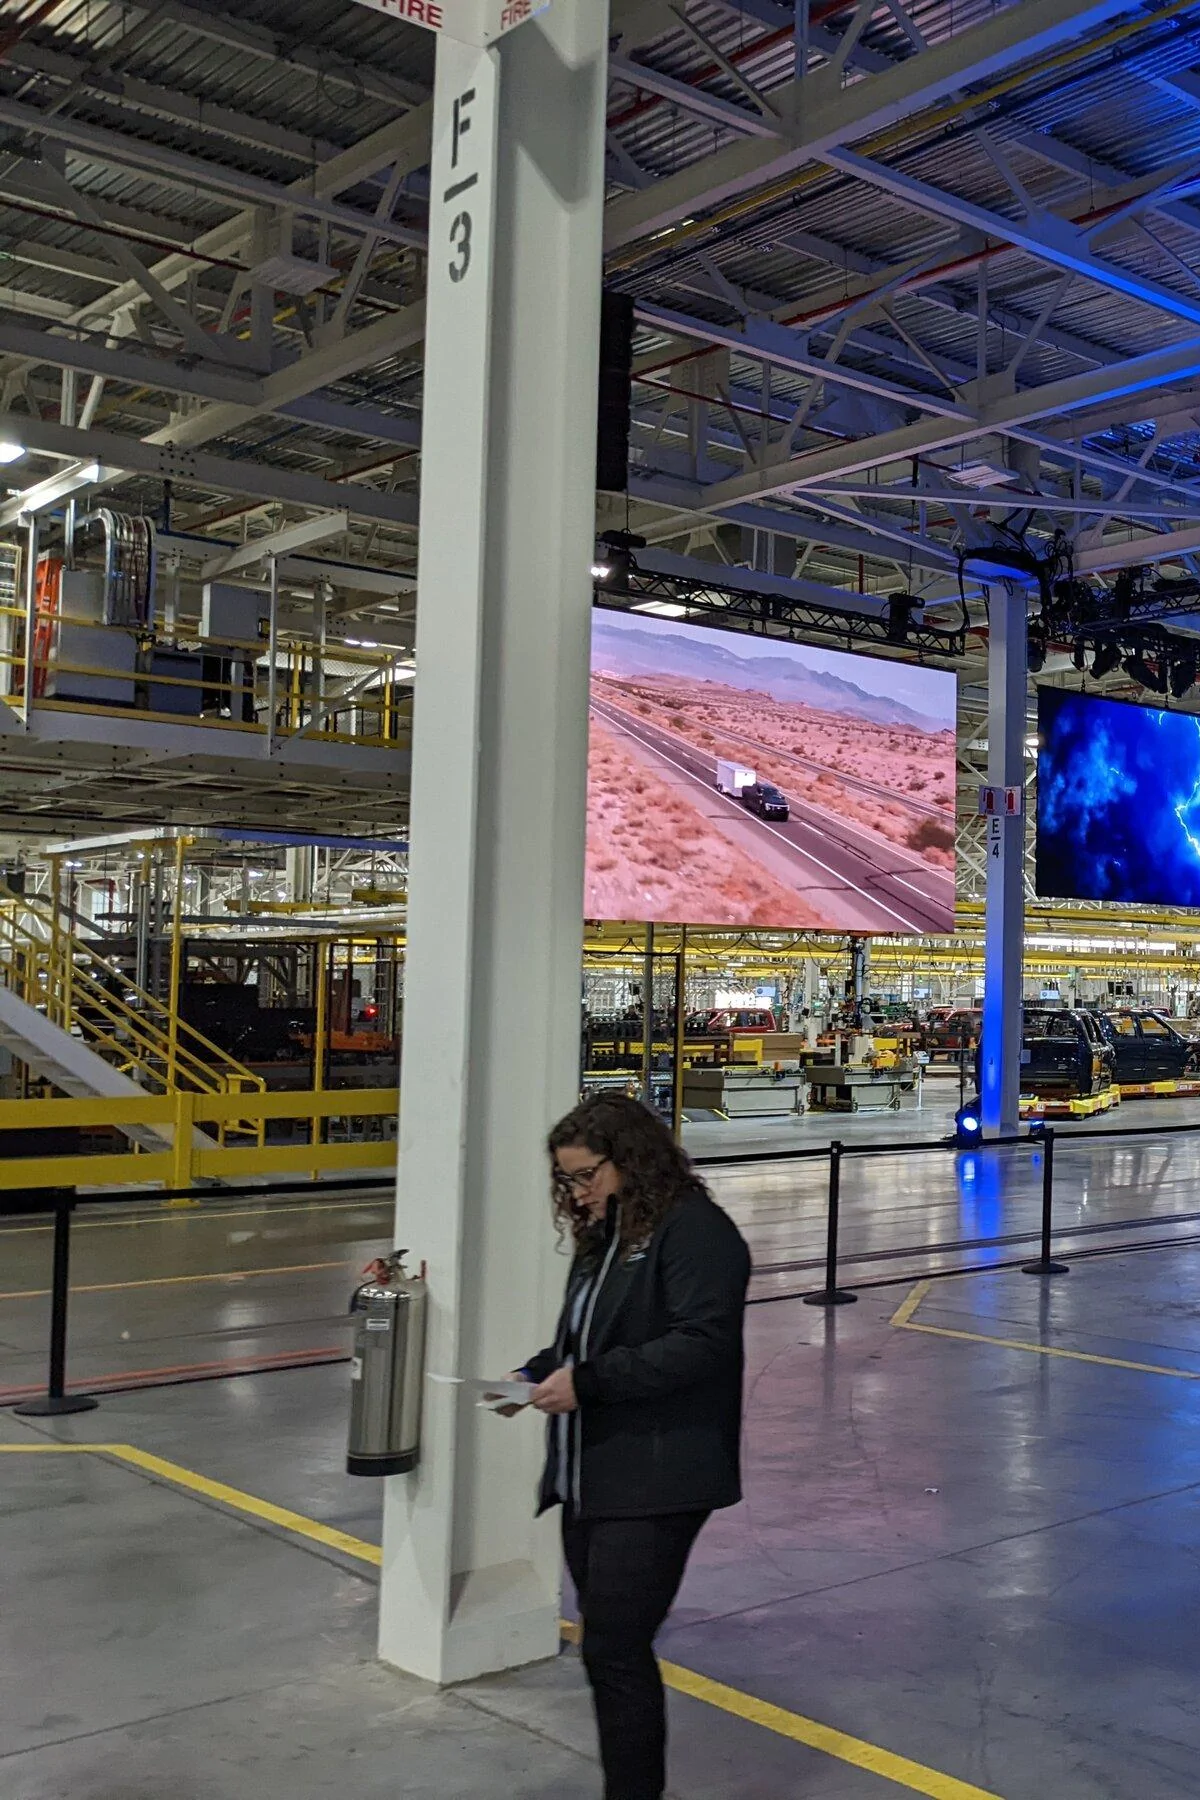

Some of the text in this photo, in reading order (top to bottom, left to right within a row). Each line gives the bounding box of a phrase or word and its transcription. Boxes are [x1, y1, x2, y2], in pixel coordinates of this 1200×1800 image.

[451, 87, 476, 169] F
[448, 210, 472, 283] 3
[992, 818, 1000, 834] E
[992, 843, 1000, 858] 4
